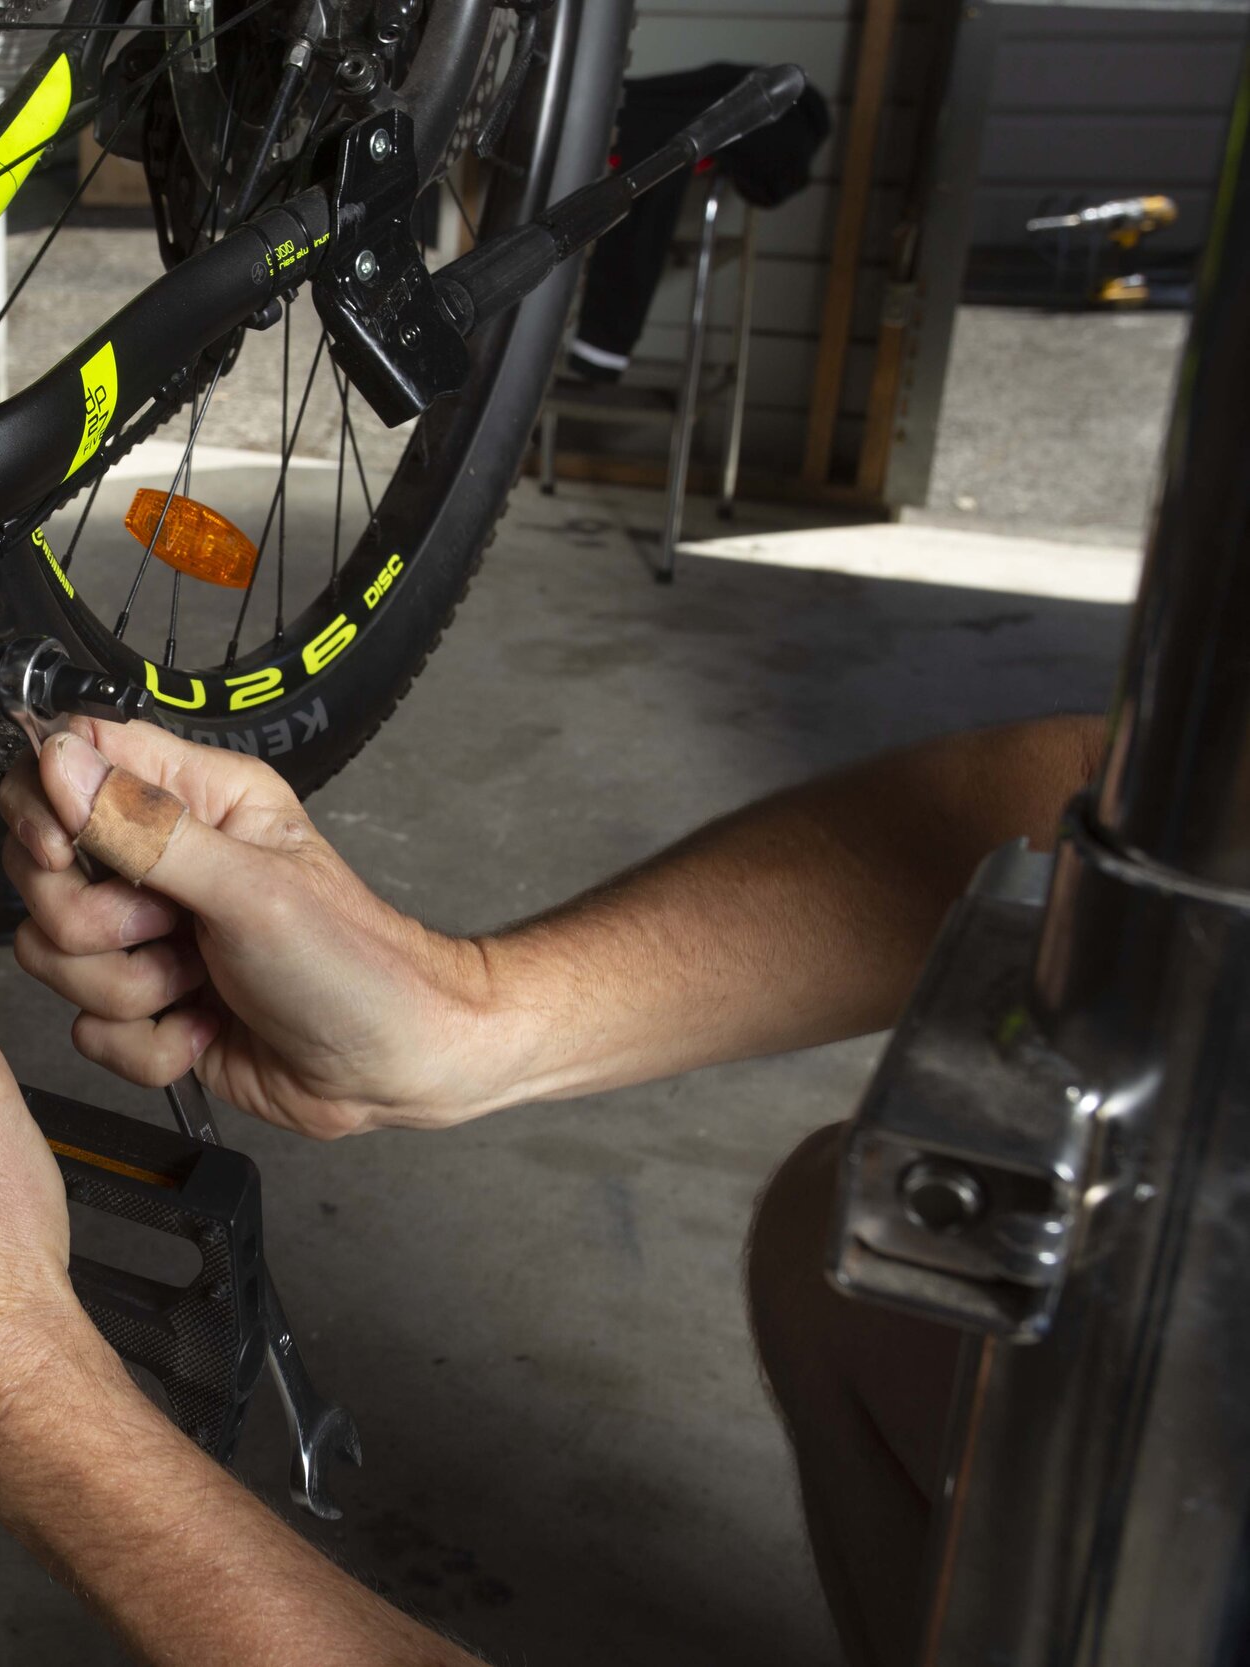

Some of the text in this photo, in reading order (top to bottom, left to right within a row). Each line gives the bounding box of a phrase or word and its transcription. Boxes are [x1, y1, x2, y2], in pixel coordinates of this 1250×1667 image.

[269, 232, 331, 277] sries aluinum
[363, 554, 404, 610] DISC
